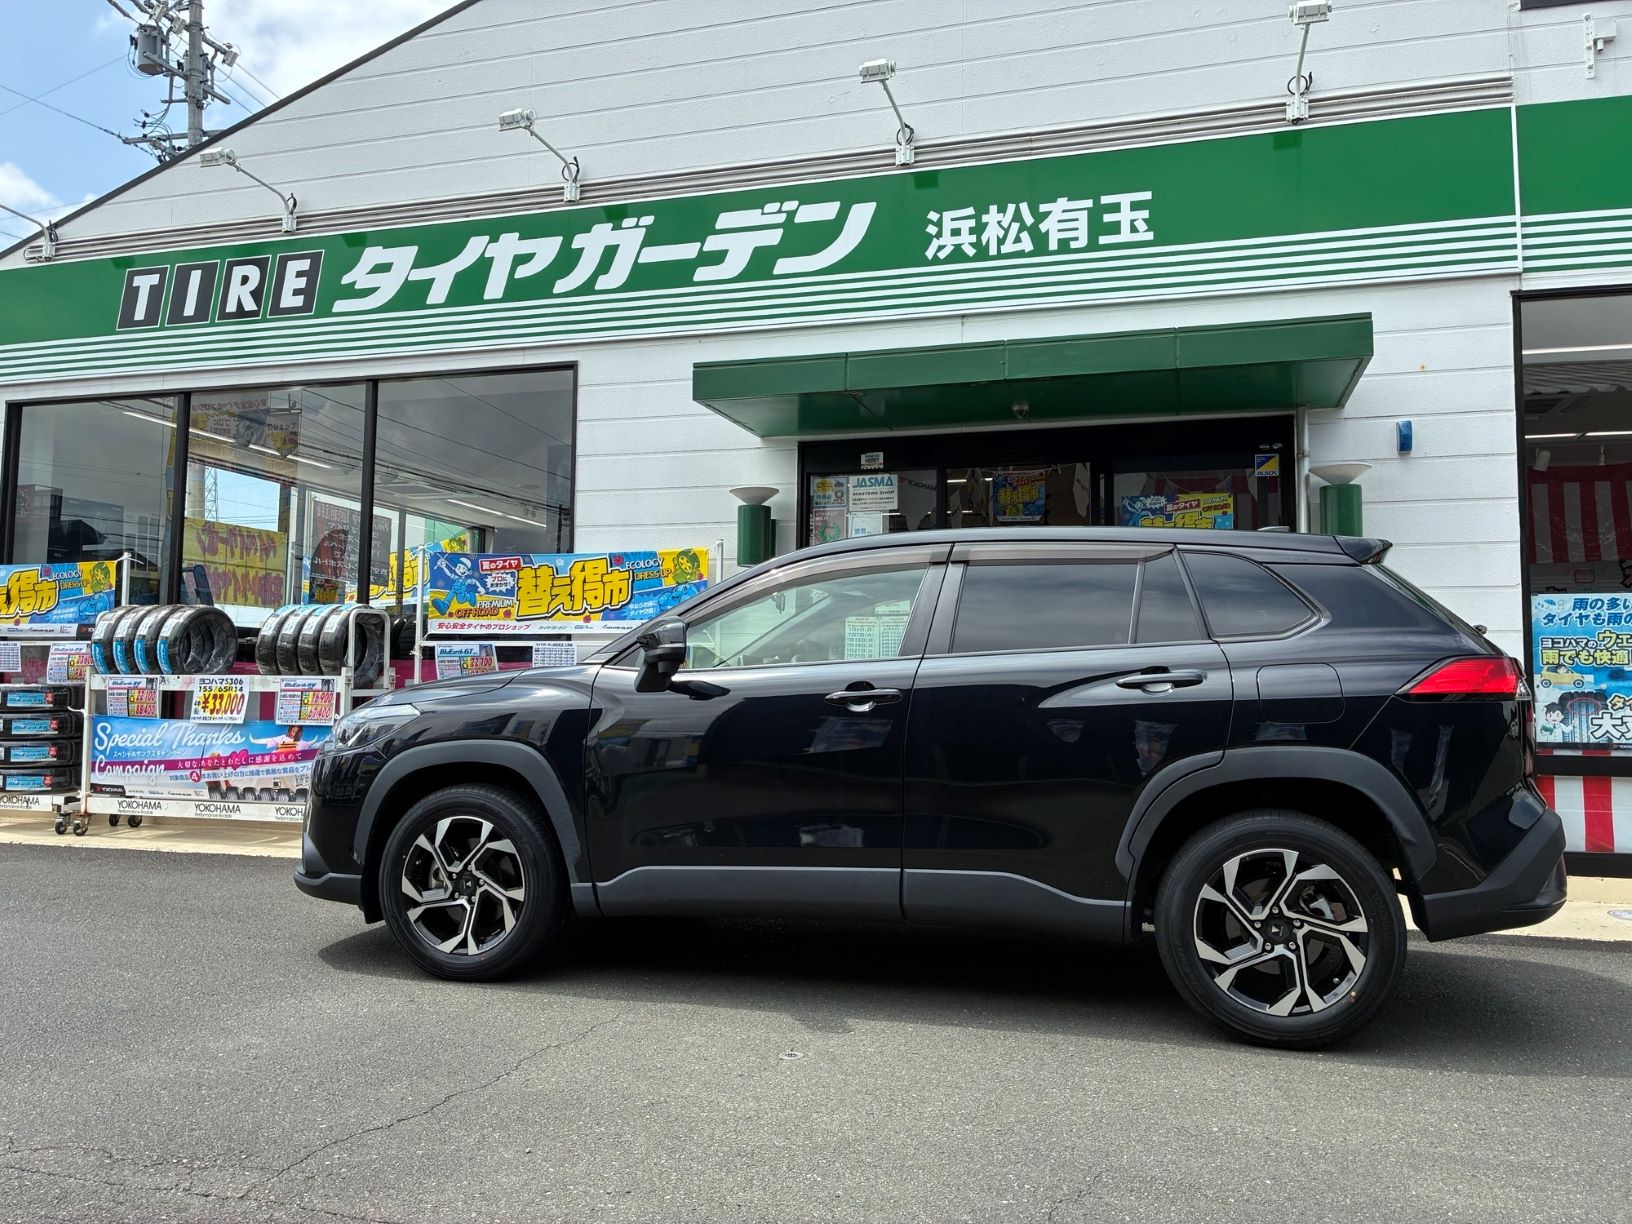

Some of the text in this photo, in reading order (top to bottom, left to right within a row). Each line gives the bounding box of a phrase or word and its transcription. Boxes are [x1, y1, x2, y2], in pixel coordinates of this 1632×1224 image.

[132, 191, 1154, 320] TIRE タイヤガーデン 浜松有玉
[852, 476, 894, 488] JASMA
[482, 560, 519, 570] 夏のタイヤ
[626, 558, 664, 569] ECOLOGY
[53, 569, 84, 580] ECOLOGY
[516, 558, 631, 618] 替え得市
[477, 599, 513, 609] PREMIUM
[437, 622, 531, 631] 安心安全タイヤのプロショップ
[199, 677, 244, 685] ヨコハマS306
[95, 722, 245, 755] Special Thanks
[95, 755, 167, 785] Campaign
[117, 800, 162, 811] YOKOHAMA
[194, 803, 241, 815] YOKOHAMA
